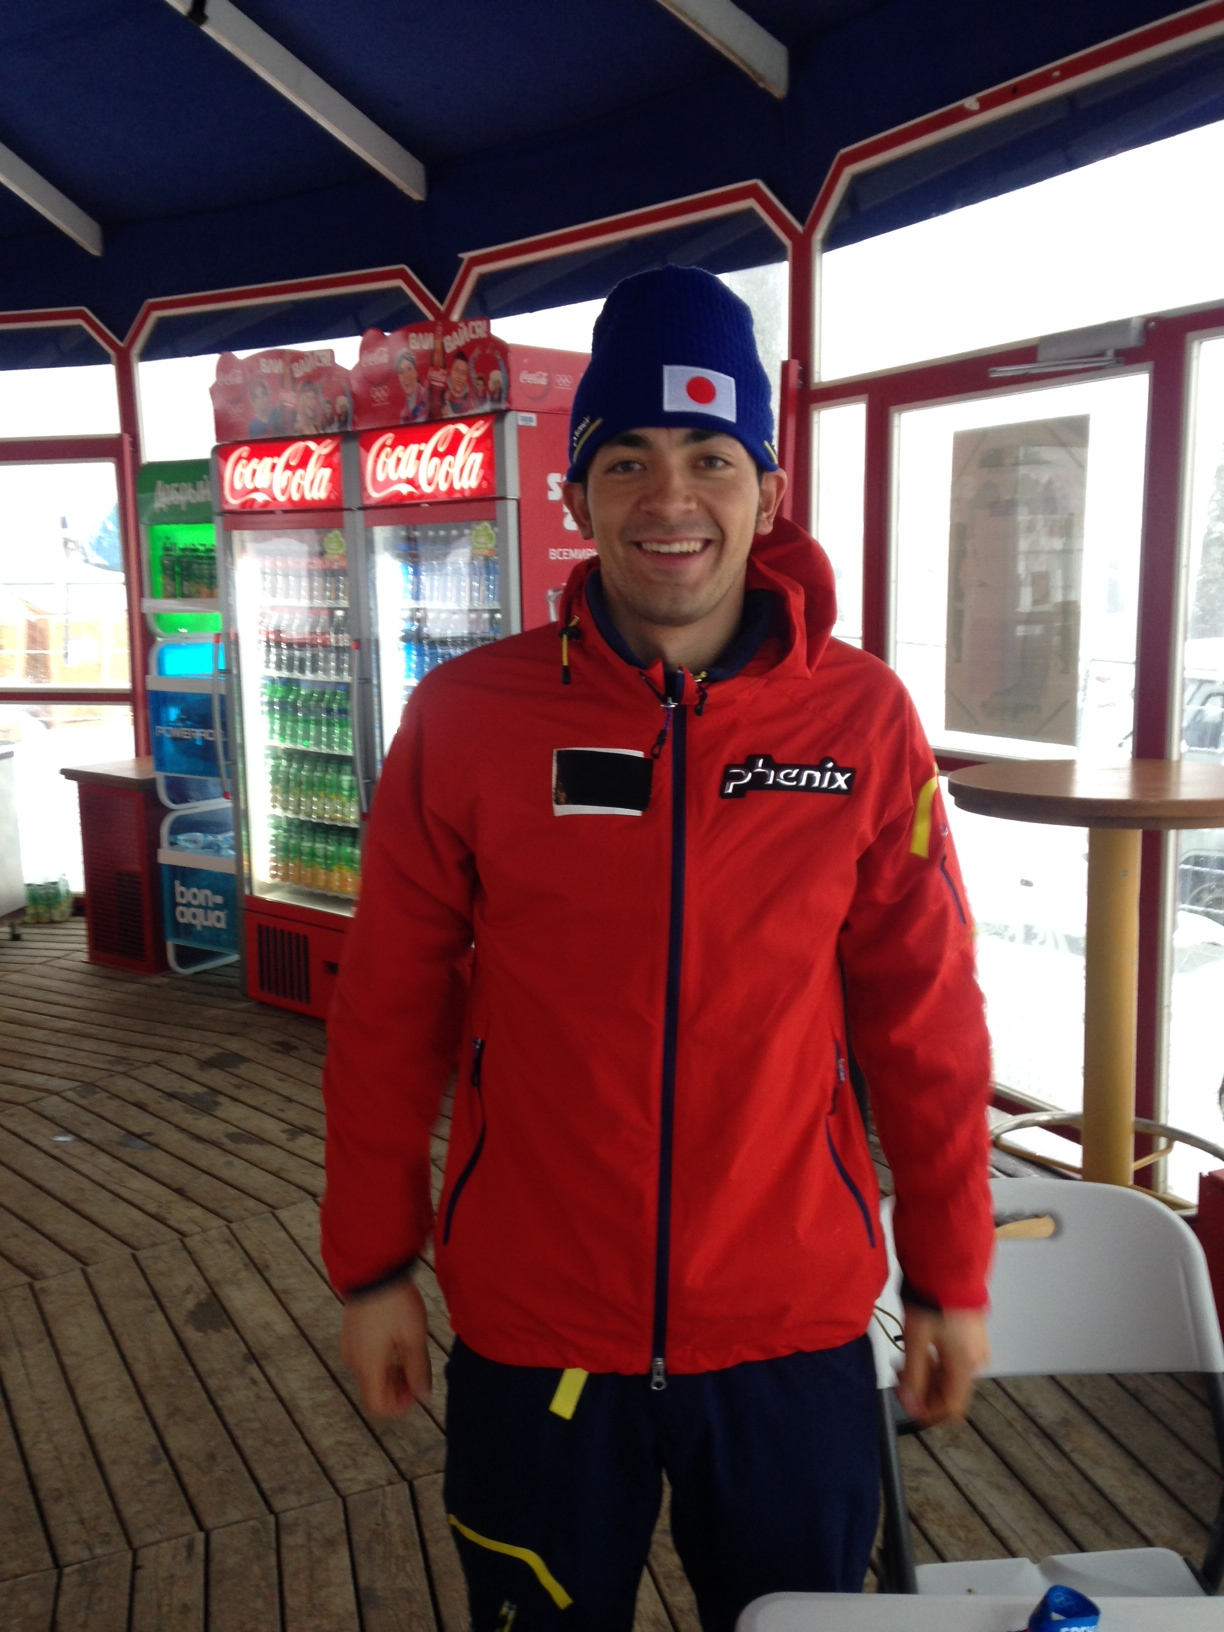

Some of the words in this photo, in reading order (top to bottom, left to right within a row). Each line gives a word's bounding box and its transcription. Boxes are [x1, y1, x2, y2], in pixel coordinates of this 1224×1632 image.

[223, 438, 338, 505] Coca-Cola
[365, 418, 490, 498] Coca-Cola
[723, 757, 852, 794] phenix
[174, 879, 224, 907] bon-
[175, 905, 228, 931] aqua
